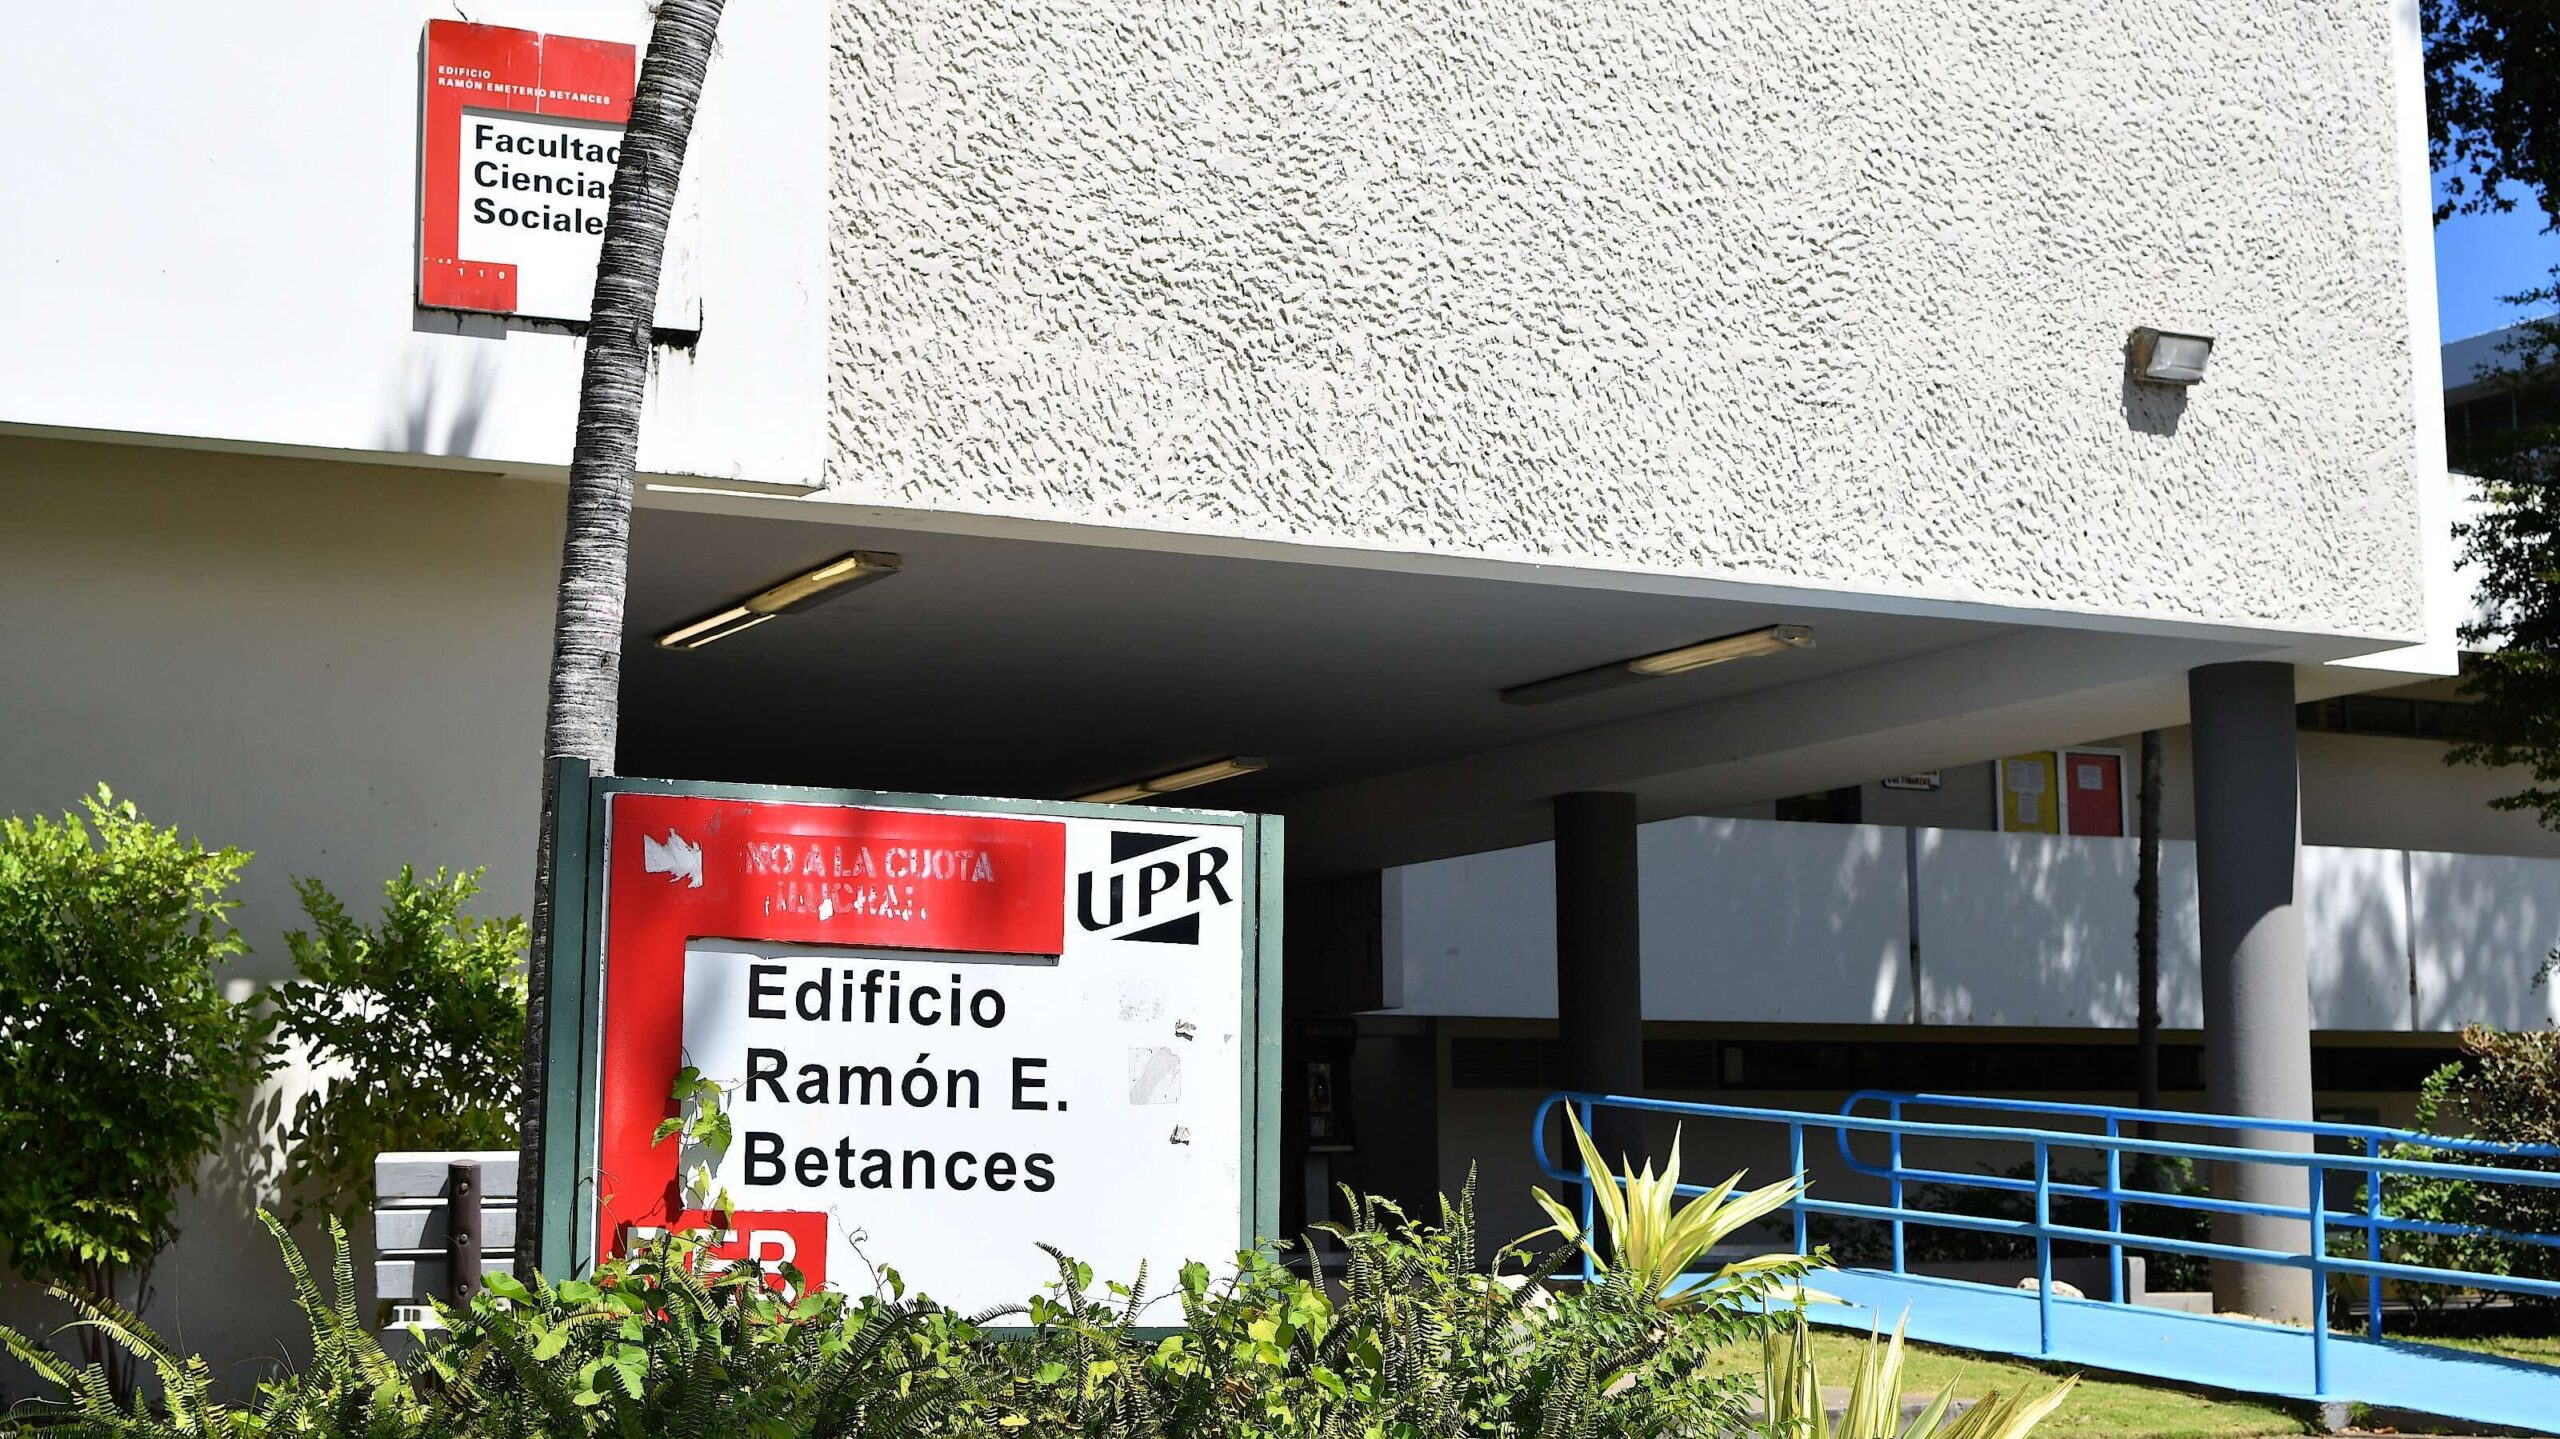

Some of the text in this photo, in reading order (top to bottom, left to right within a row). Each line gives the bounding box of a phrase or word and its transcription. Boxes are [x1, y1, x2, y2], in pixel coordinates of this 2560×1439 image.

[438, 65, 491, 80] EDIFICIO
[438, 76, 611, 105] RAMÓN EMETERIO BETANCES
[474, 161, 616, 199] Ciencia
[474, 197, 605, 235] Sociale
[746, 842, 995, 883] NO A LA CUOTA
[1078, 847, 1233, 931] UPR
[748, 963, 1006, 1029] Edificio
[745, 1047, 1068, 1112] Ramón E.
[743, 1131, 1056, 1193] Betances
